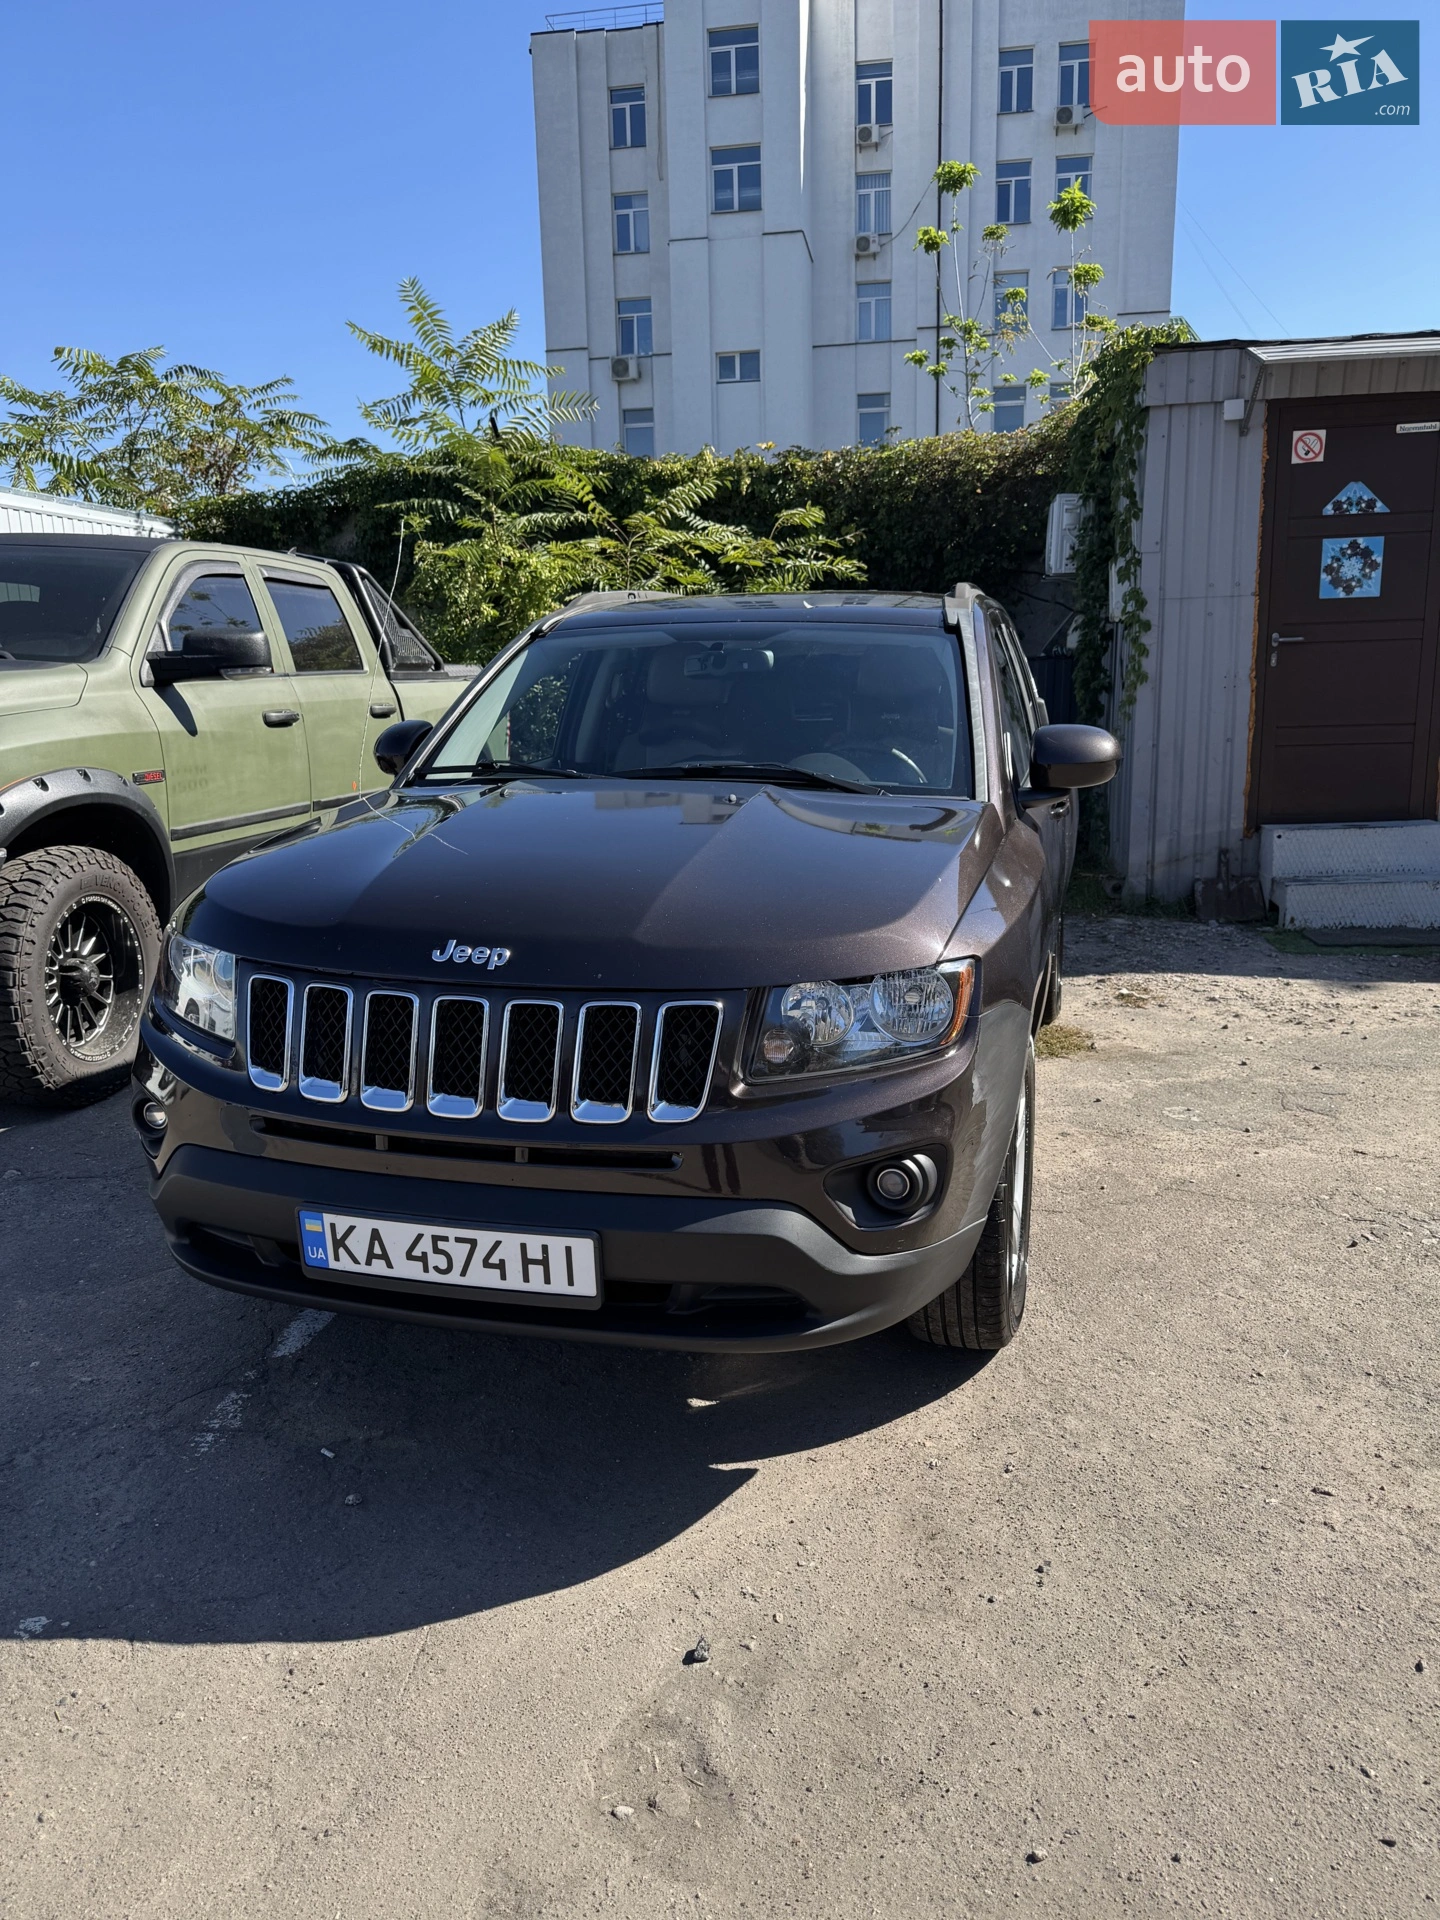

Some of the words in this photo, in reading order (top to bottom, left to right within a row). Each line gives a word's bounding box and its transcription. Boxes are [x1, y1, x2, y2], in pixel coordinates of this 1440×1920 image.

[144, 772, 164, 781] DIESEL
[431, 939, 511, 970] Jeep
[308, 1246, 326, 1260] UA
[329, 1222, 394, 1269] KA
[405, 1233, 507, 1281] 4574
[520, 1242, 575, 1287] HI
